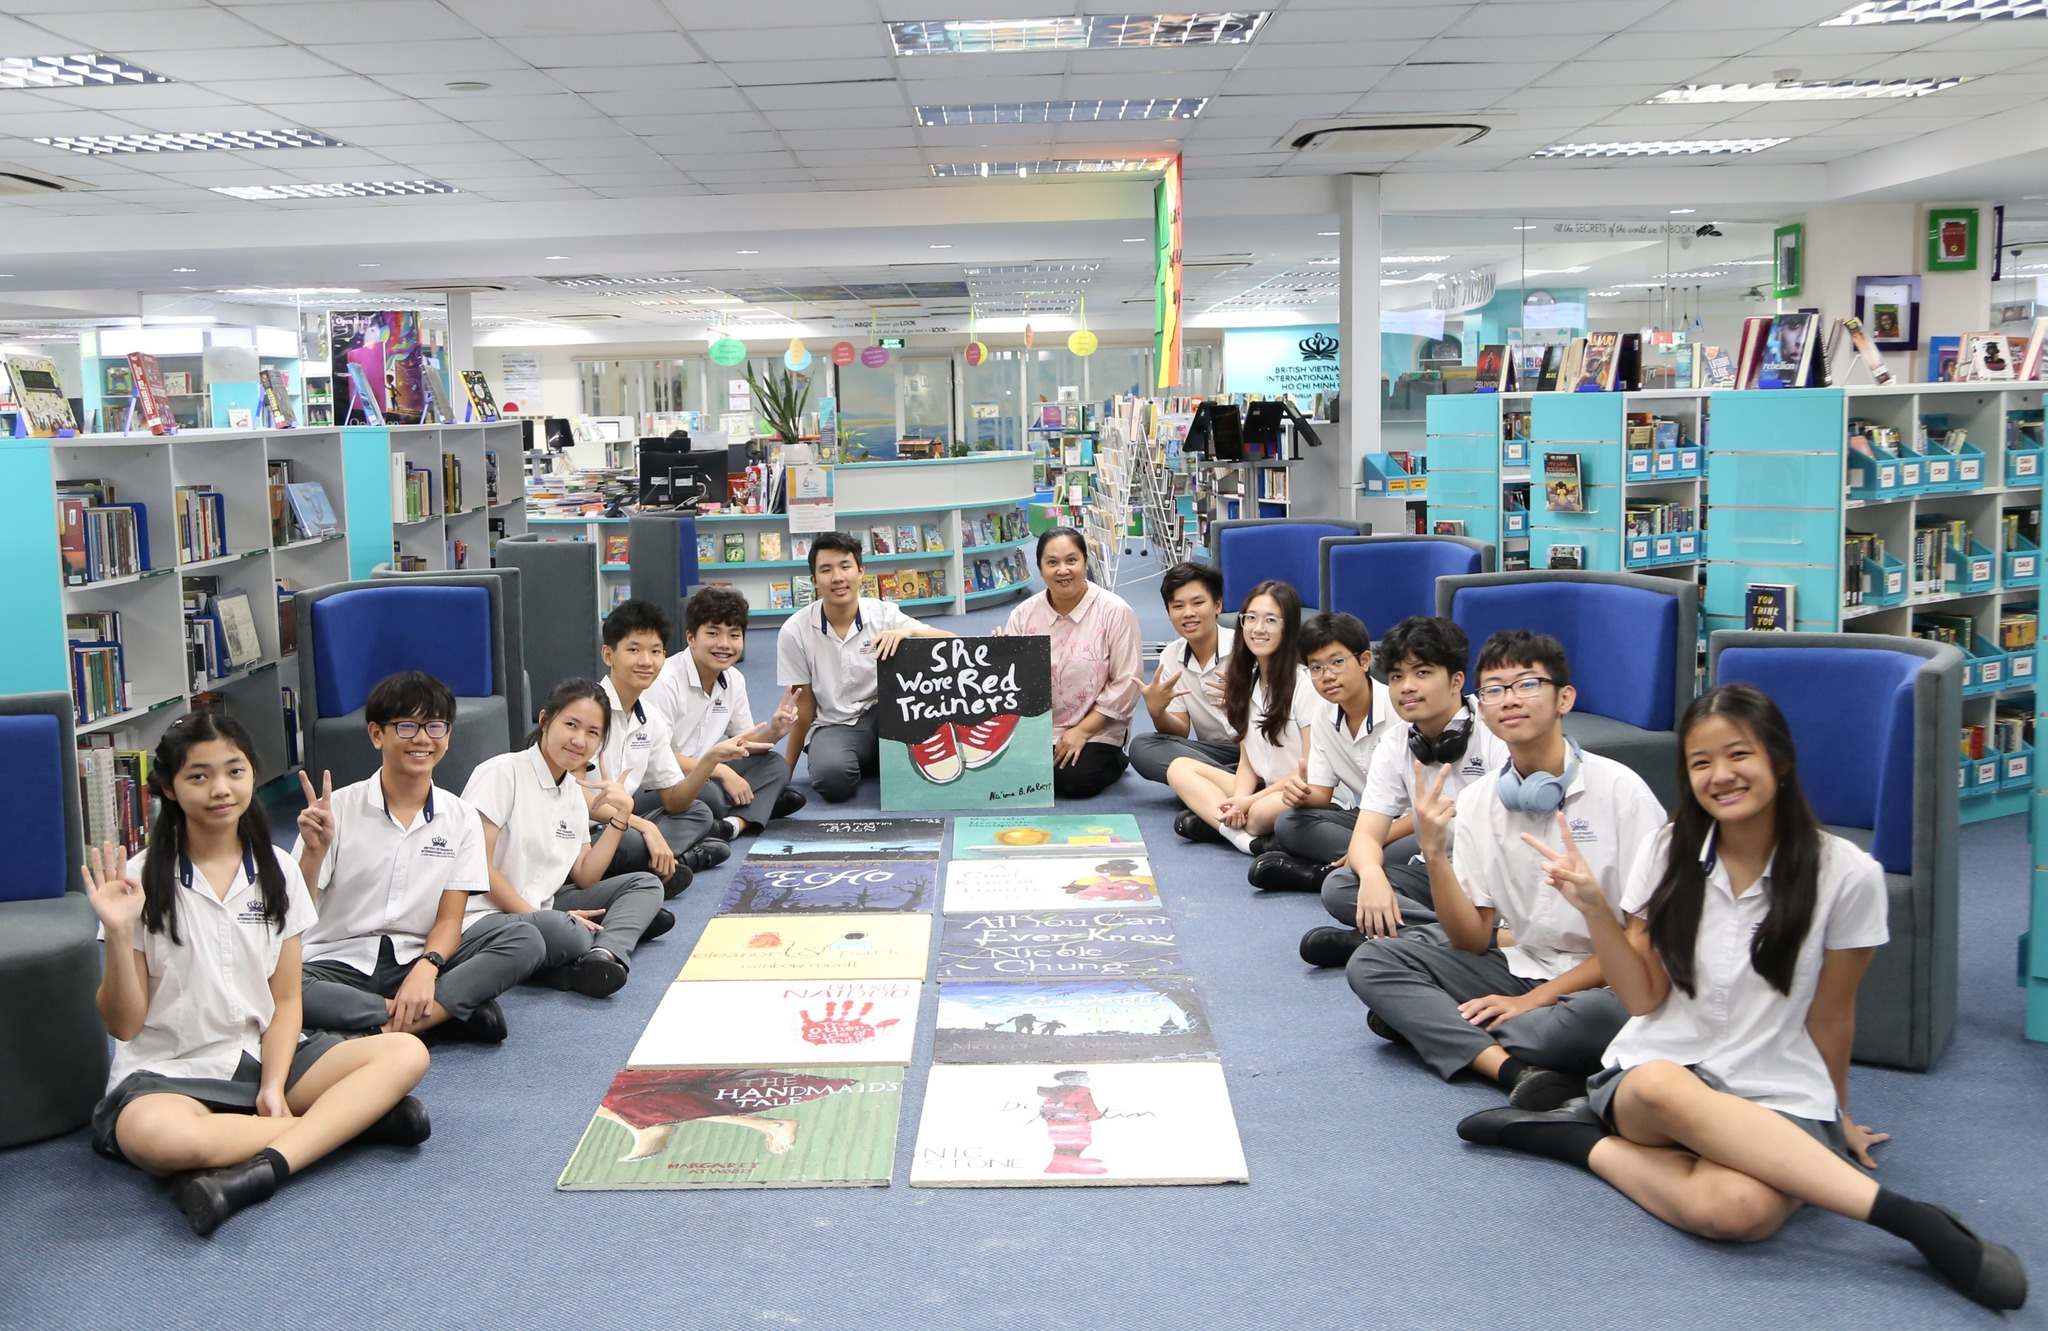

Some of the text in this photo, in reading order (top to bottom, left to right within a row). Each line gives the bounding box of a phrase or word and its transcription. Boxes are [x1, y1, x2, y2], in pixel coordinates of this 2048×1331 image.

[1576, 224, 1606, 233] SECRETS
[1669, 224, 1696, 234] BOOKS
[1266, 374, 1335, 382] INTERNATIONAL
[1313, 382, 1336, 390] MINH
[930, 639, 991, 673] She
[896, 663, 1021, 697] Wore Red
[897, 692, 1018, 722] Trainers
[764, 868, 896, 891] ECHO
[962, 911, 1172, 930] All You Can
[980, 927, 1175, 943] Ever Know
[993, 959, 1129, 975] Chung
[714, 1081, 900, 1100] HANDMAID'S
[739, 1077, 799, 1088] THE
[734, 1097, 802, 1108] TALE
